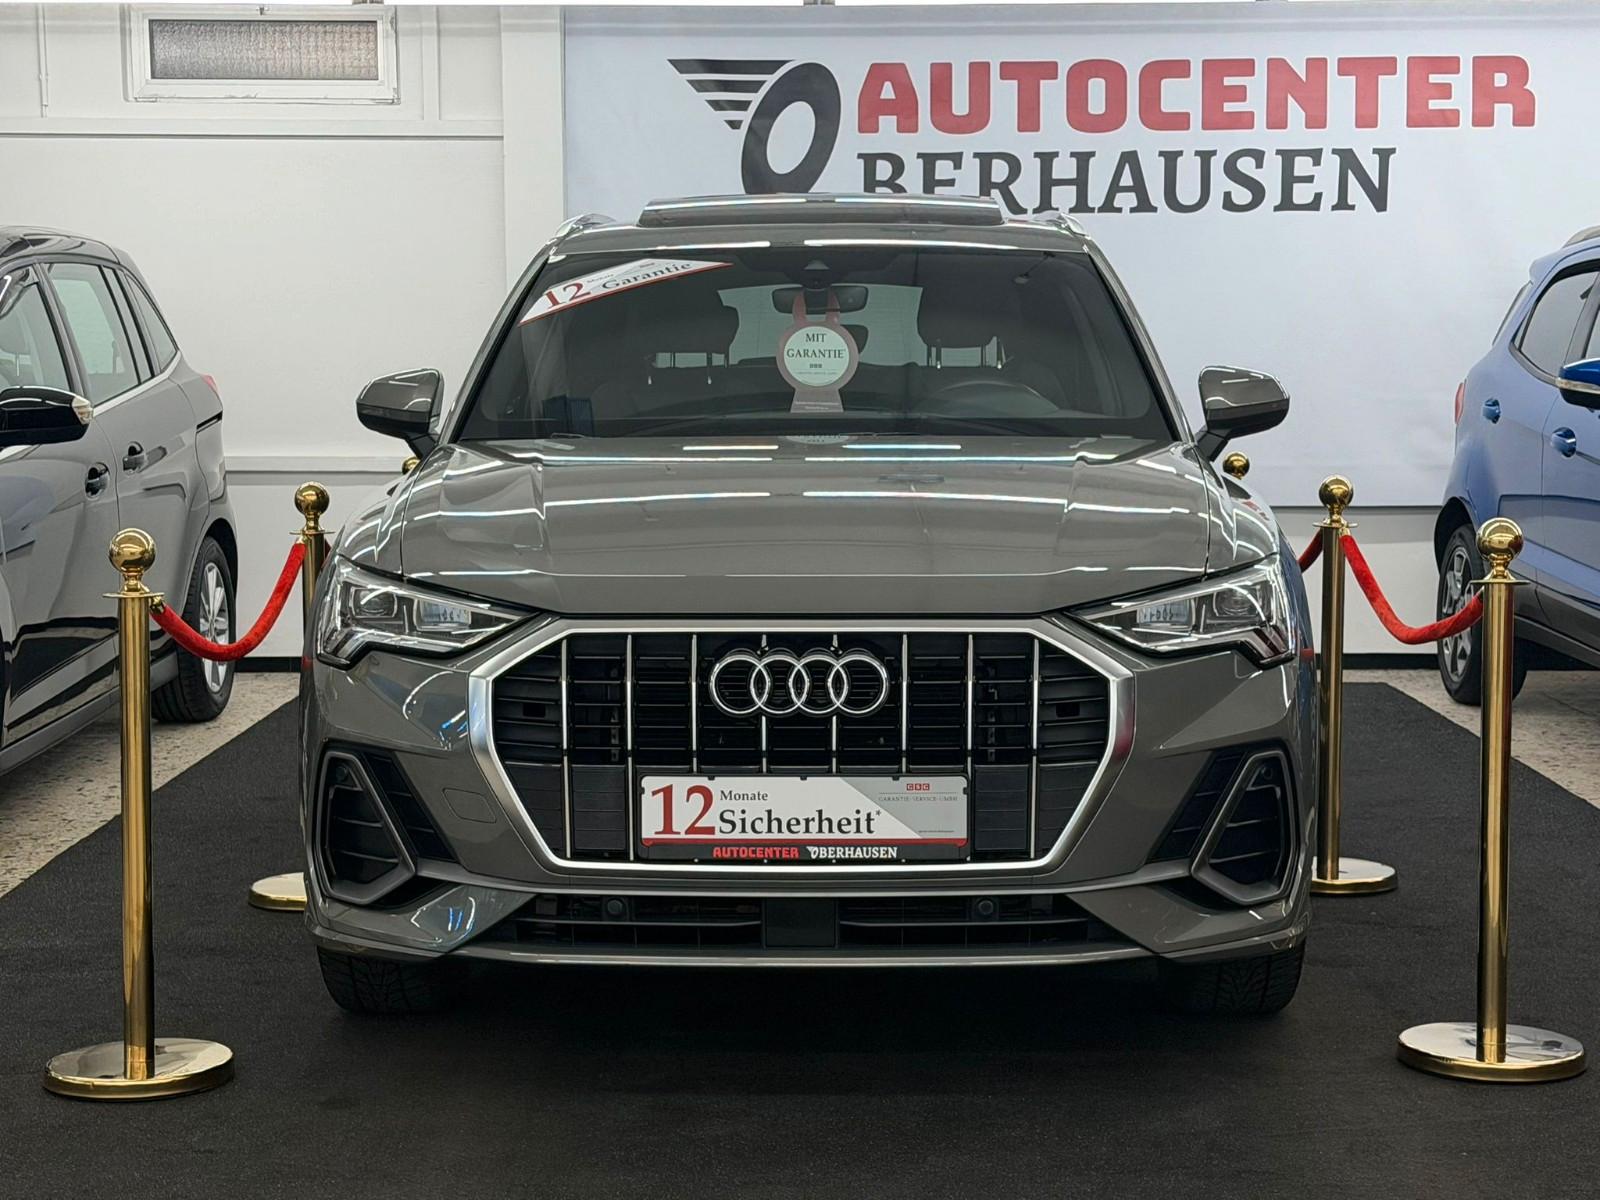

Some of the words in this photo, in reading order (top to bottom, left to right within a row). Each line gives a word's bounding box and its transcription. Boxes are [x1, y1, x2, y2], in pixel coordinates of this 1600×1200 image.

[857, 55, 1536, 135] AUTOCENTER
[544, 282, 591, 309] 12
[601, 262, 691, 290] Garantie
[805, 333, 826, 343] MIT
[651, 783, 716, 836] 12
[719, 788, 768, 802] Monate
[712, 847, 799, 859] AUTOCENTER
